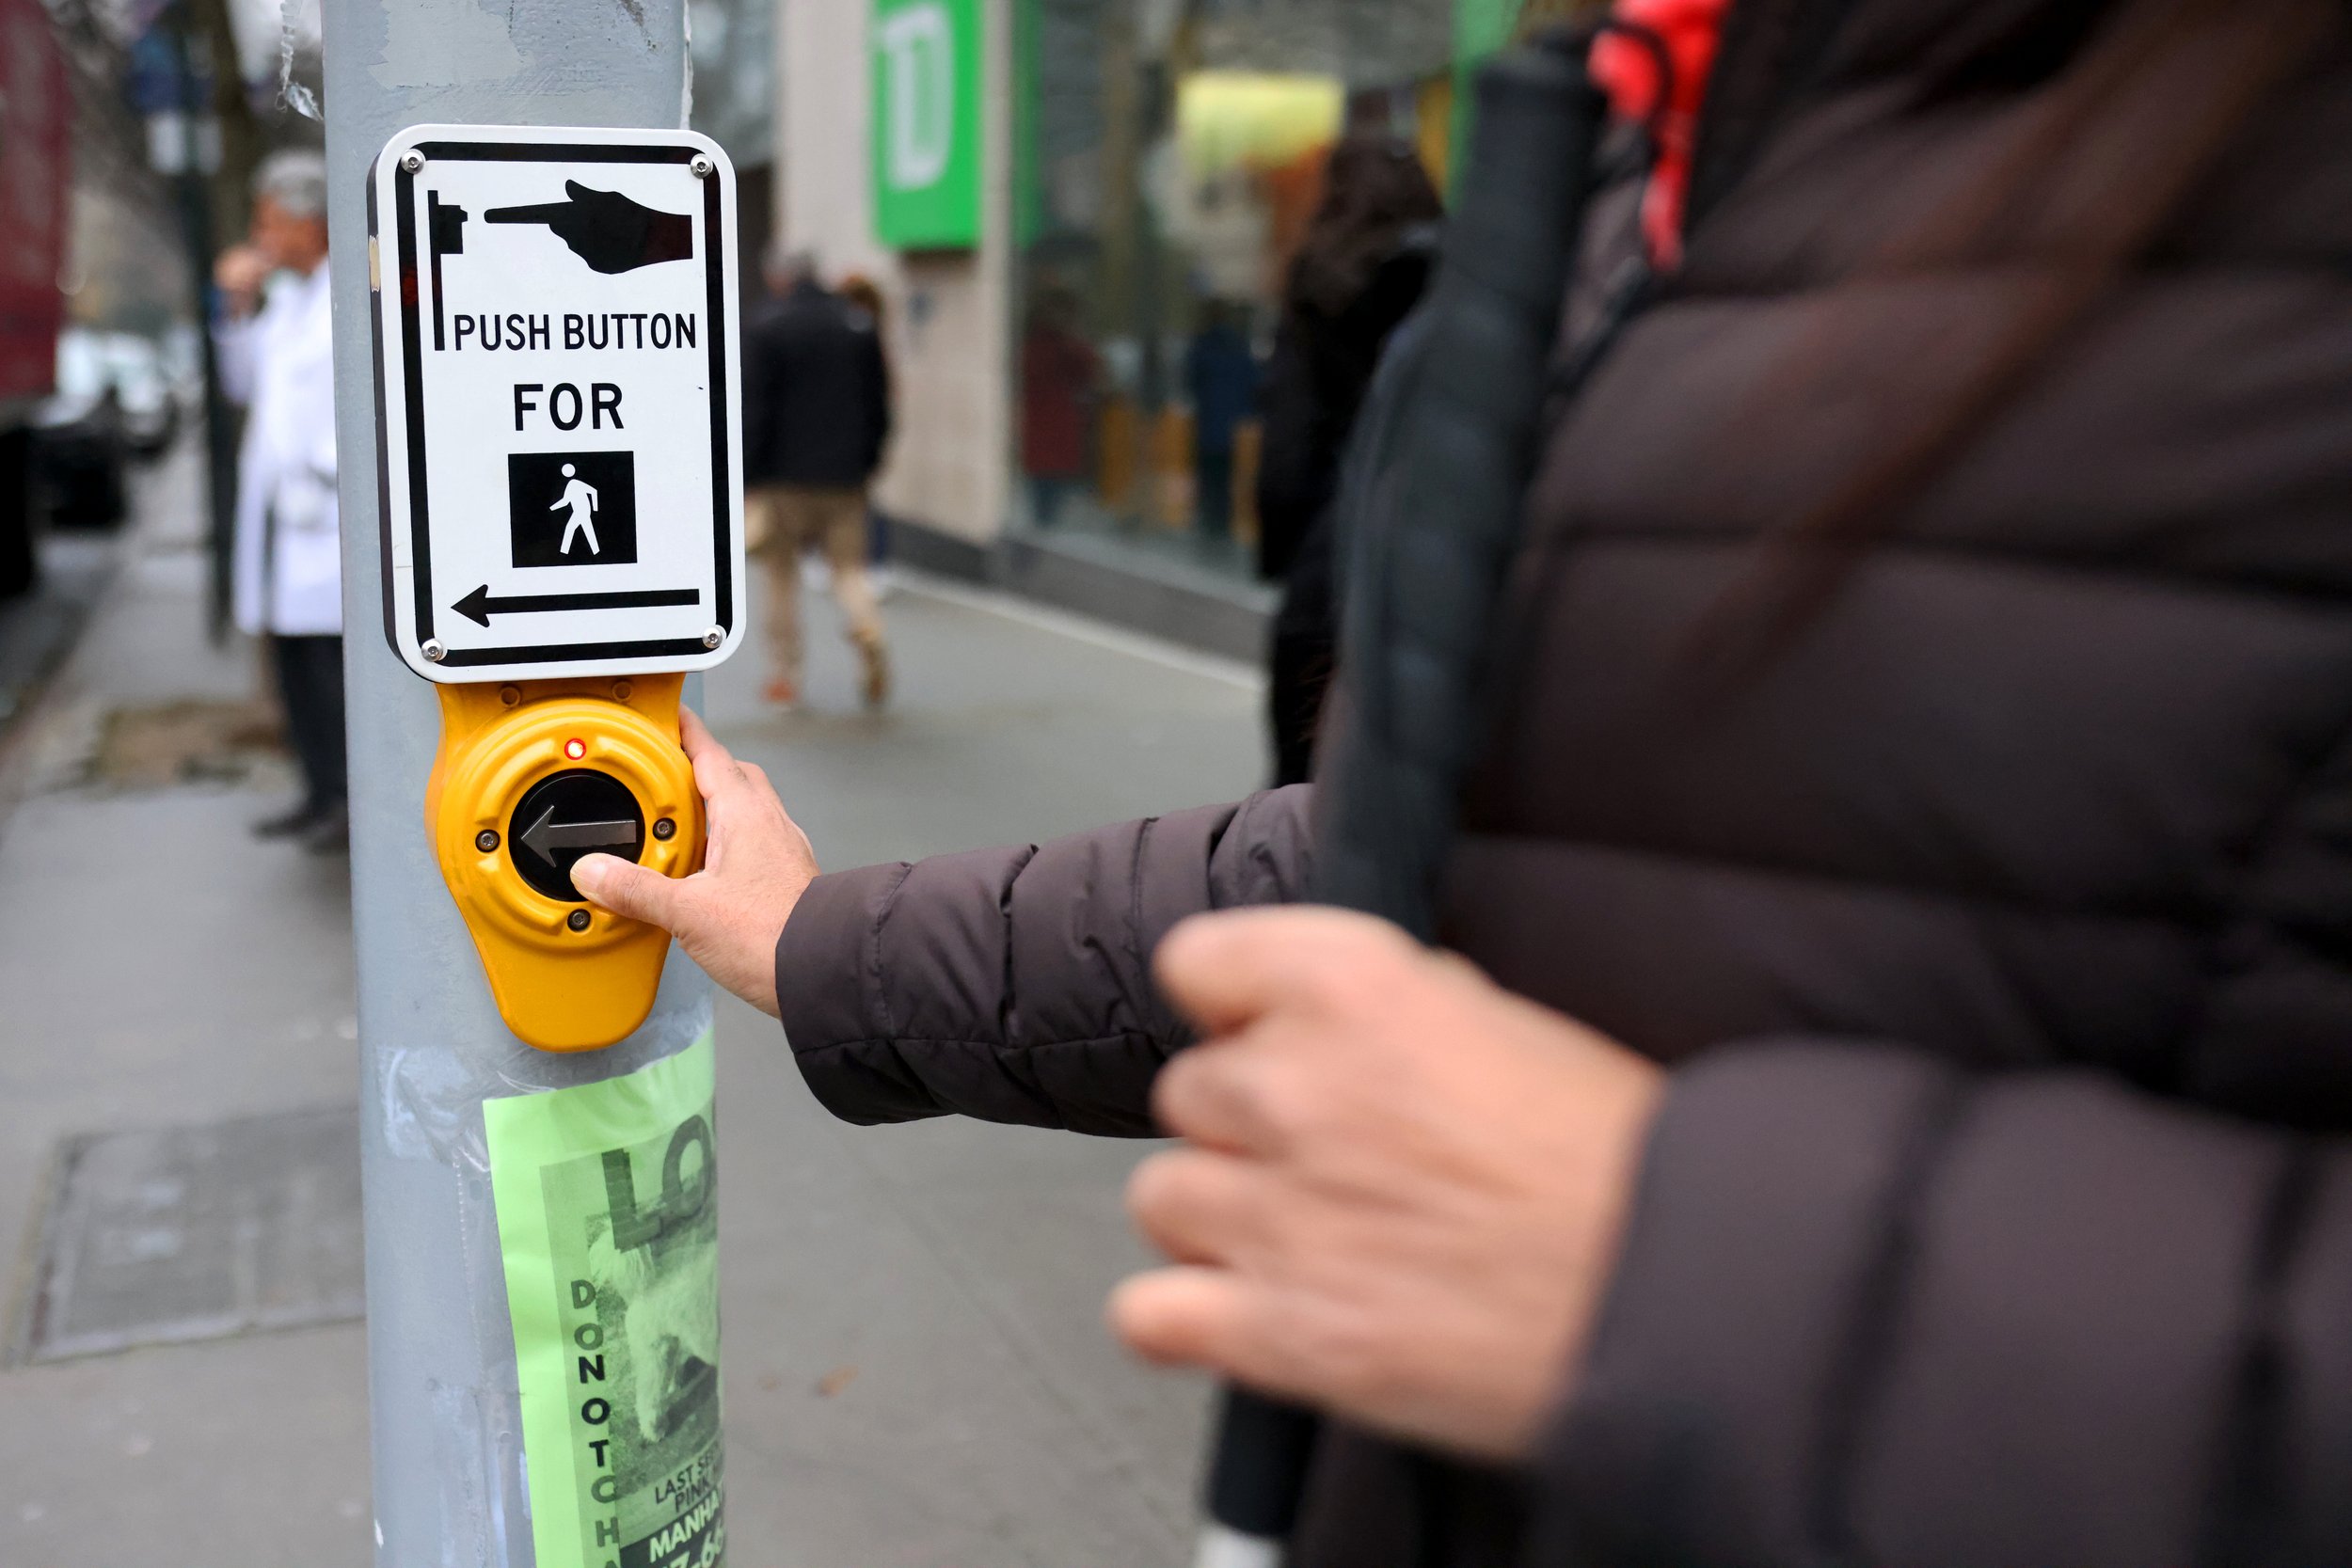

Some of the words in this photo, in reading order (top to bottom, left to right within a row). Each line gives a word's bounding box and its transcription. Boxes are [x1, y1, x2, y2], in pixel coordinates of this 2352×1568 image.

[454, 313, 550, 351] PUSH
[564, 313, 696, 349] BUTTON
[514, 383, 624, 431] FOR
[601, 1114, 716, 1254] LO
[655, 1464, 693, 1504] LAST
[649, 1489, 721, 1563] MANHA
